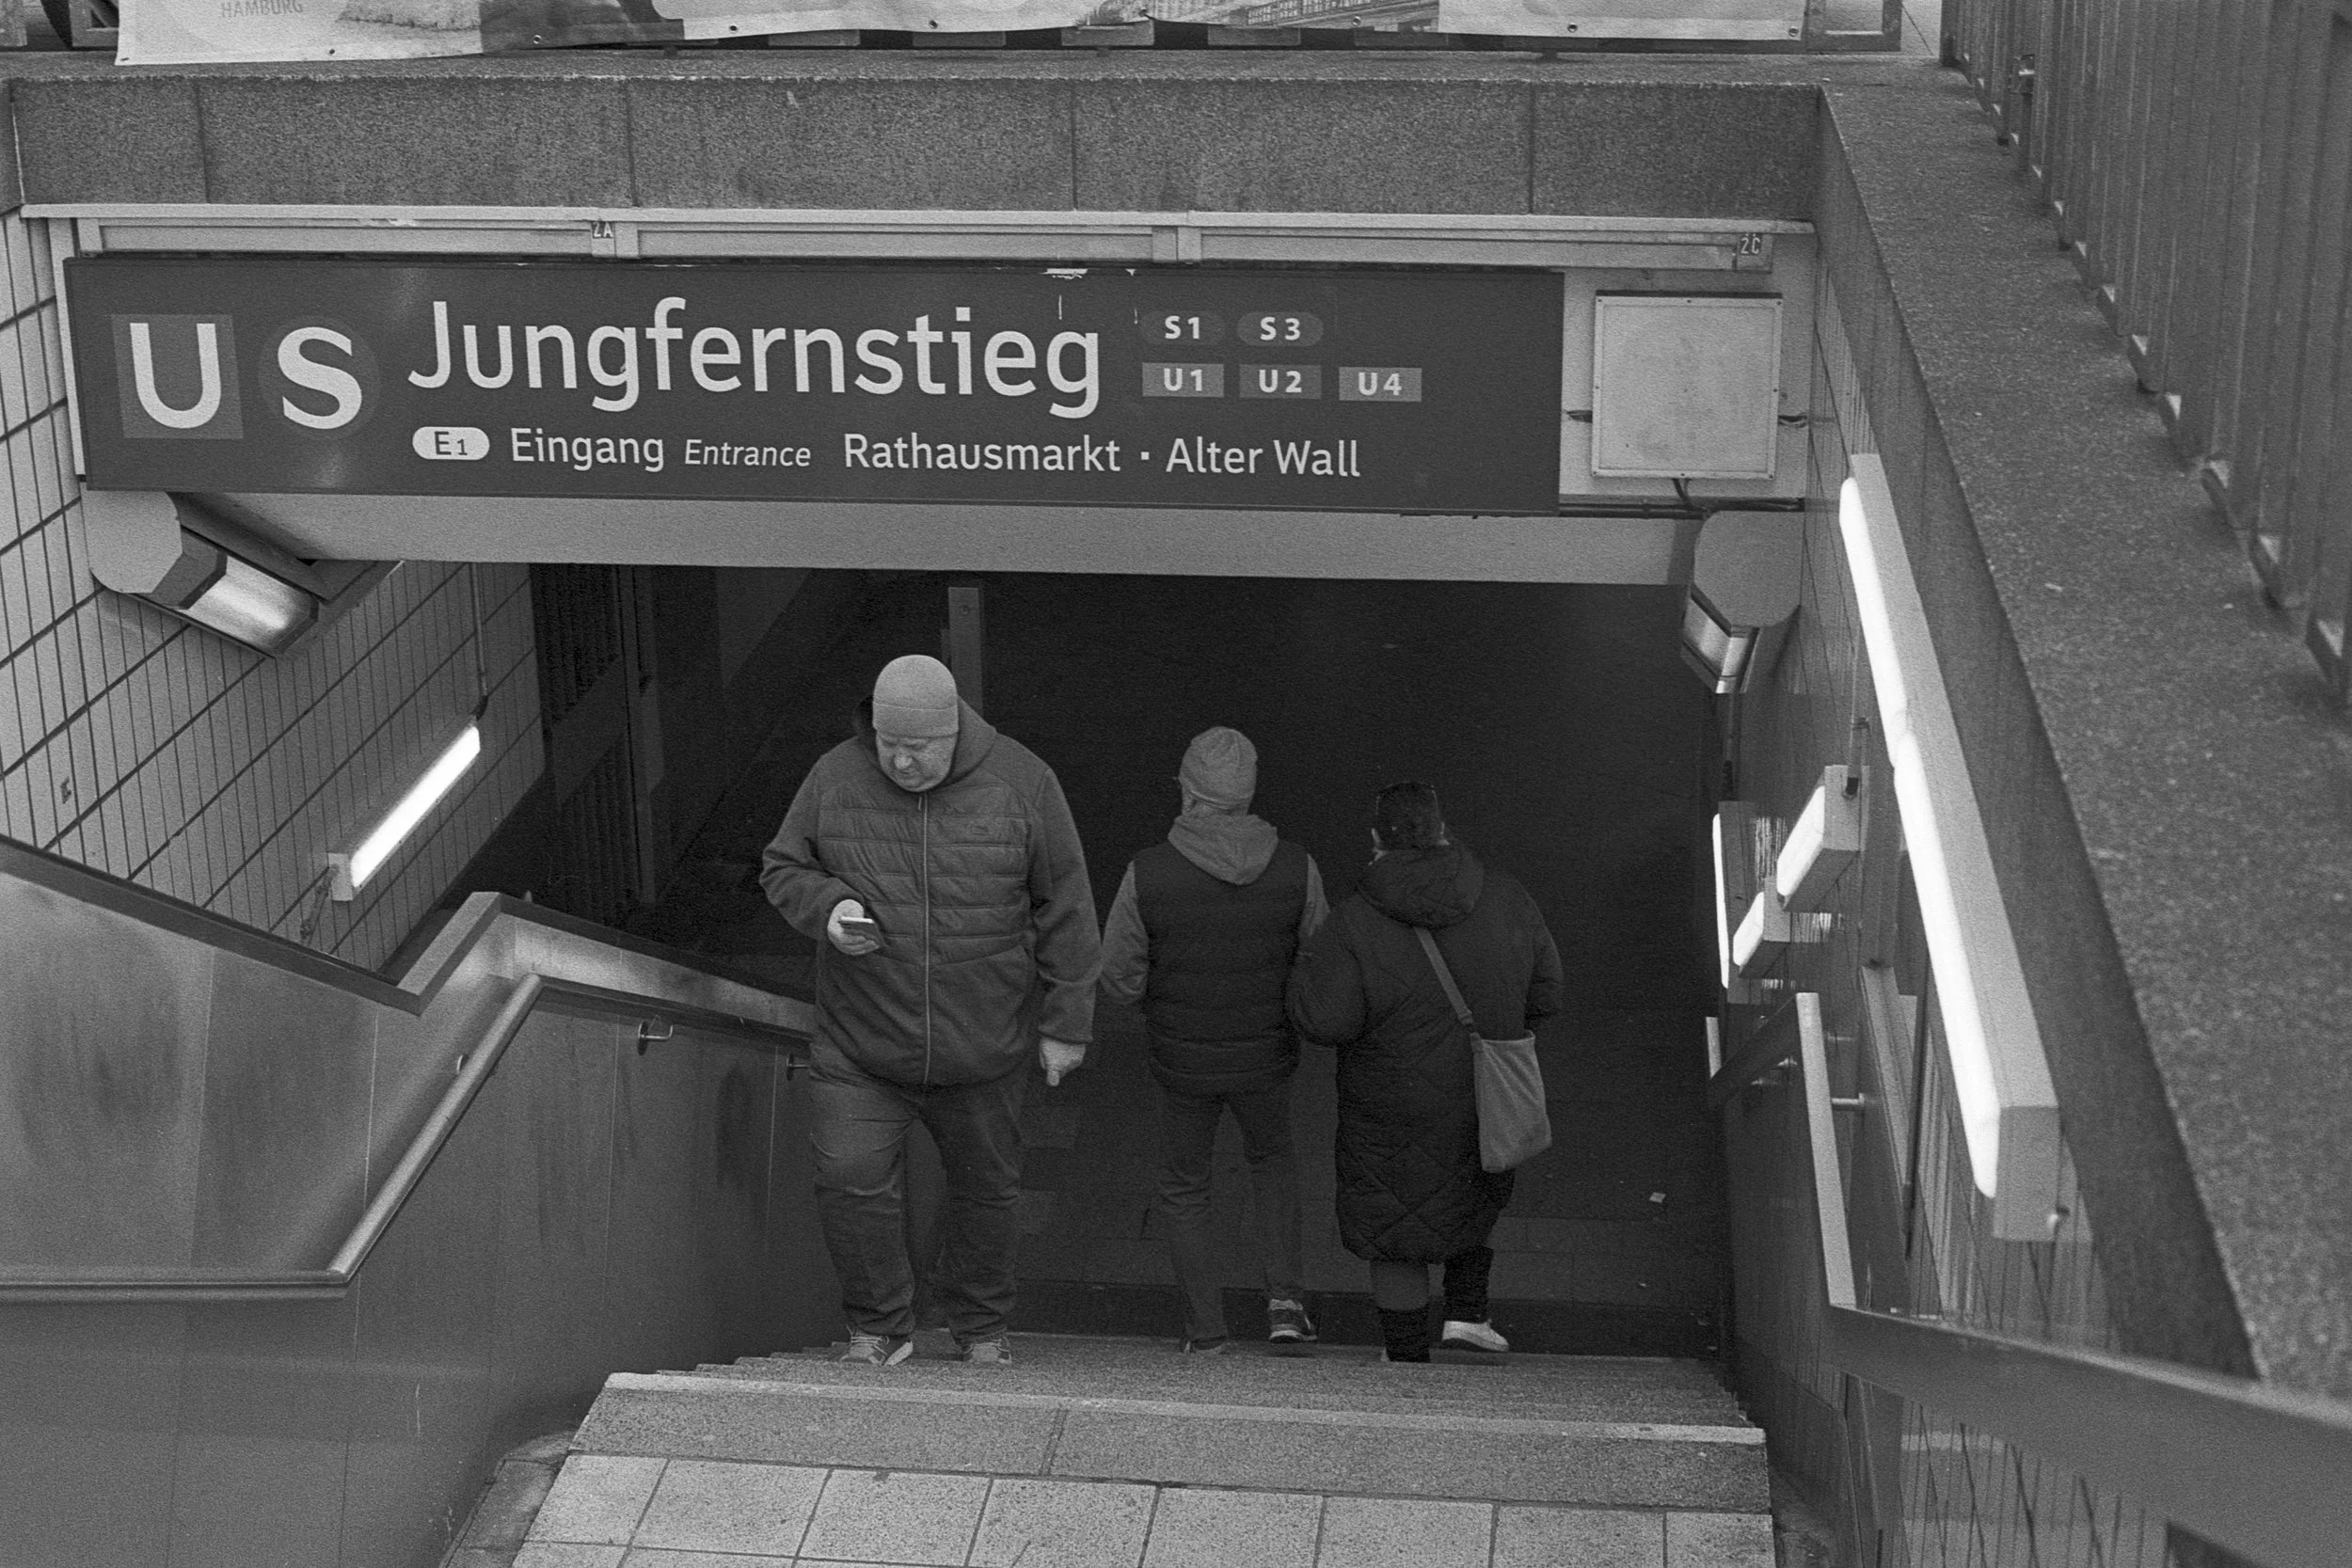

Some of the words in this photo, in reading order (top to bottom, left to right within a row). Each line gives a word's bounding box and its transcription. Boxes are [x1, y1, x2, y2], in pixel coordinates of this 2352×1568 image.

[220, 0, 303, 18] HAMBURG
[593, 222, 613, 237] 2A
[1740, 237, 1760, 254] 2C
[1165, 315, 1200, 340] S1
[1261, 316, 1300, 341] S3
[130, 323, 221, 429] U
[278, 327, 362, 430] S
[408, 297, 1100, 420] Jungfernstieg
[1164, 368, 1203, 391] U1
[1259, 370, 1302, 393] U2
[1359, 372, 1402, 395] U4
[434, 431, 469, 456] E1
[511, 428, 664, 472] Eingang
[685, 438, 811, 467] Entrance
[845, 432, 1120, 472] Rathausmarkt
[1166, 436, 1263, 474] Alter
[1274, 439, 1360, 477] Wall
